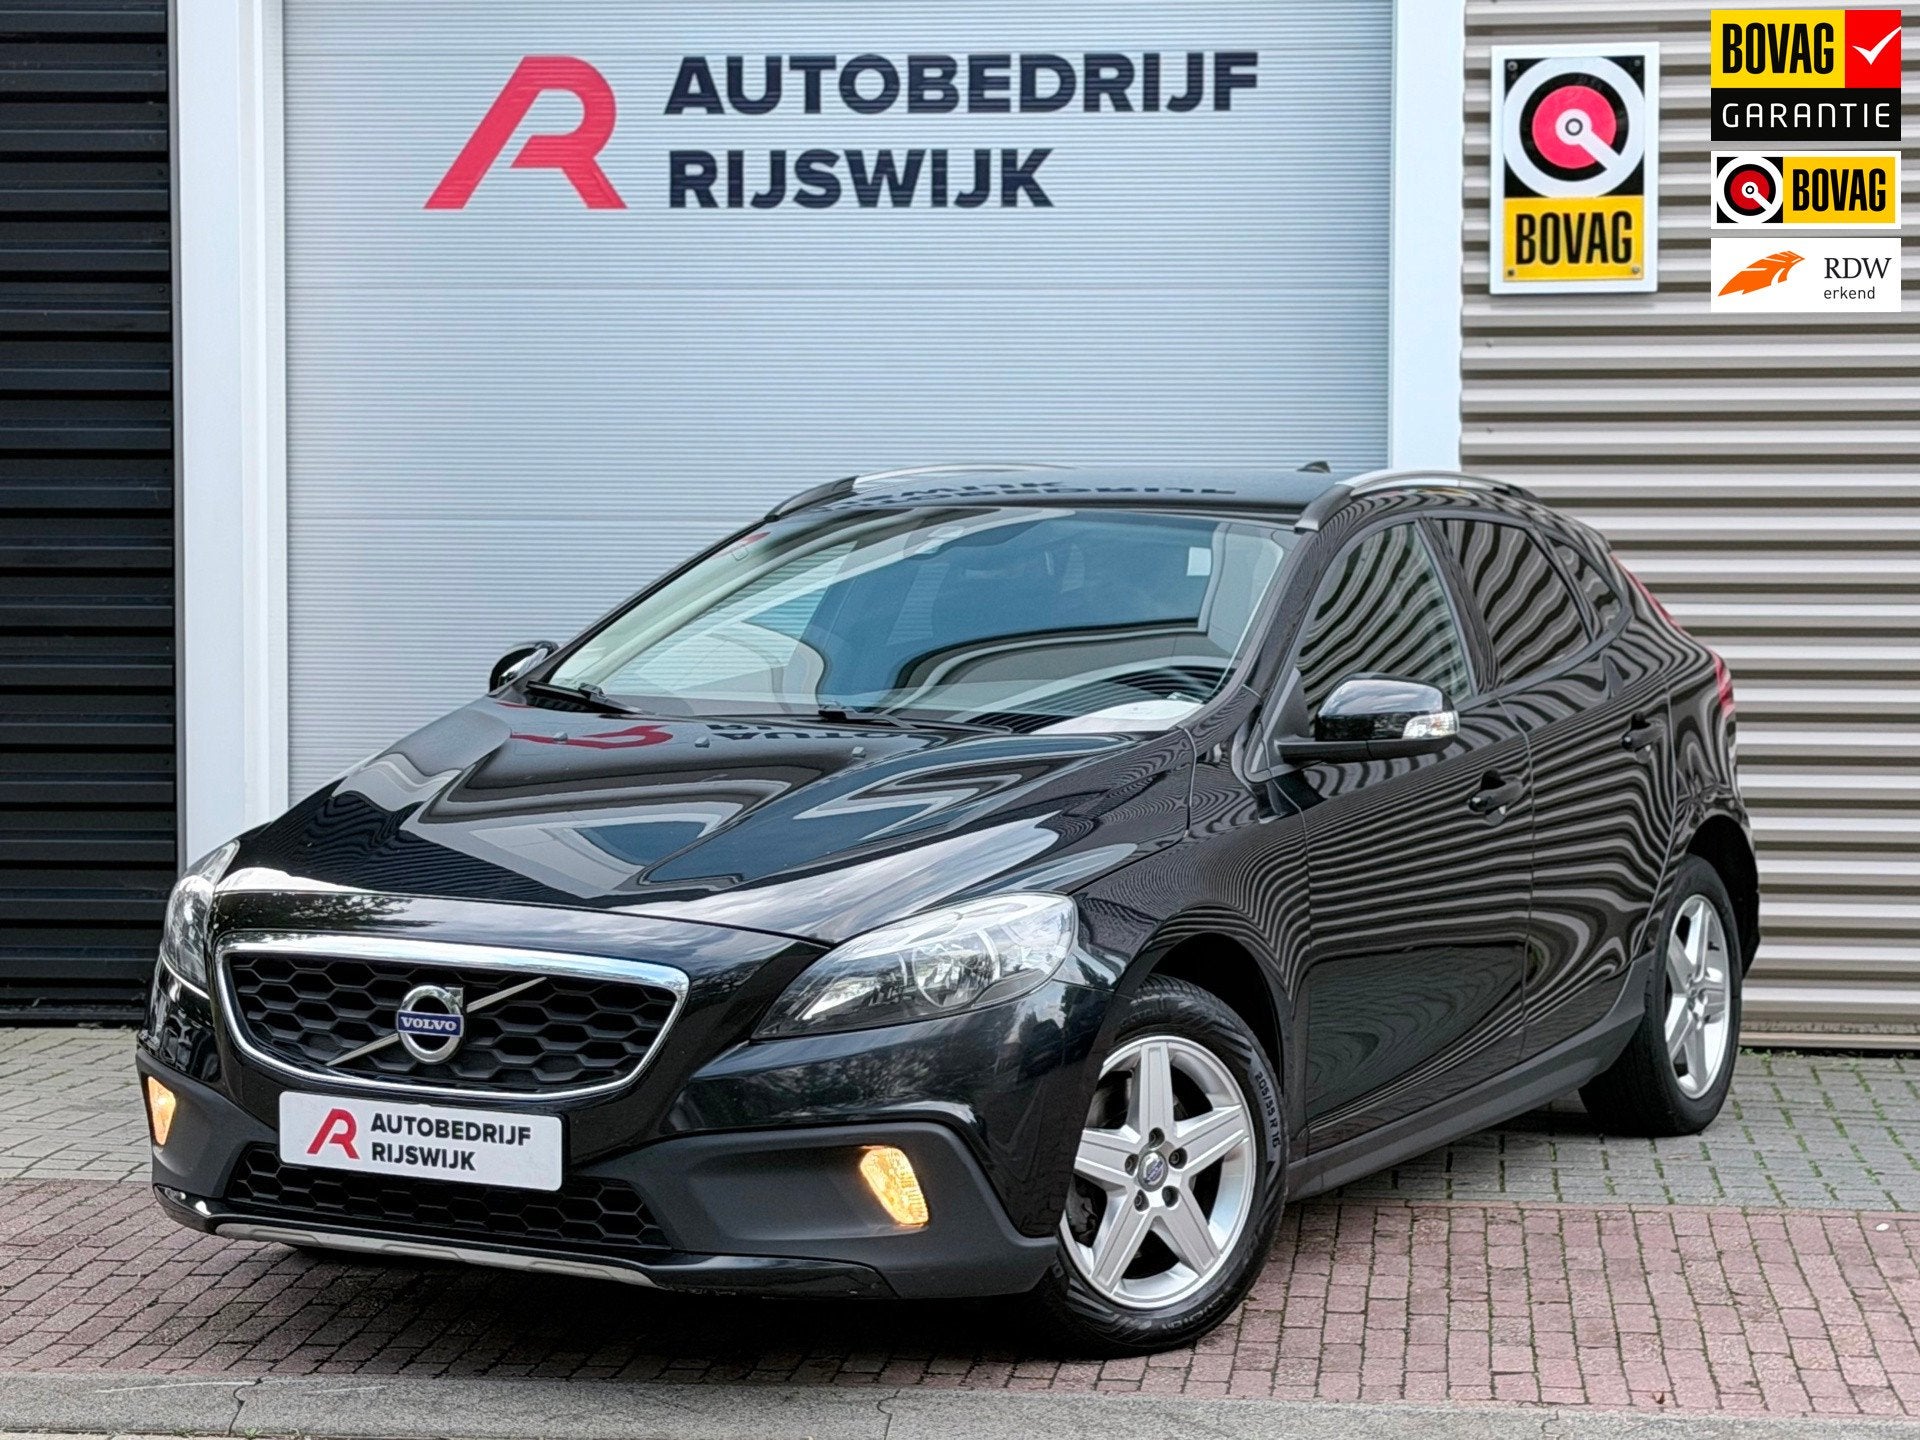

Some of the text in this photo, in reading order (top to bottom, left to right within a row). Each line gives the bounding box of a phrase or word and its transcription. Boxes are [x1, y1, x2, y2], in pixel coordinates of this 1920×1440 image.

[664, 51, 1258, 116] AUTOBEDRIJF
[668, 148, 1053, 209] RIJSWIJK
[1515, 211, 1633, 266] BOVAG
[399, 1015, 458, 1032] VOLVO
[370, 1112, 532, 1147] AUTOBEDRIJF
[371, 1142, 477, 1171] RIJSWIJK
